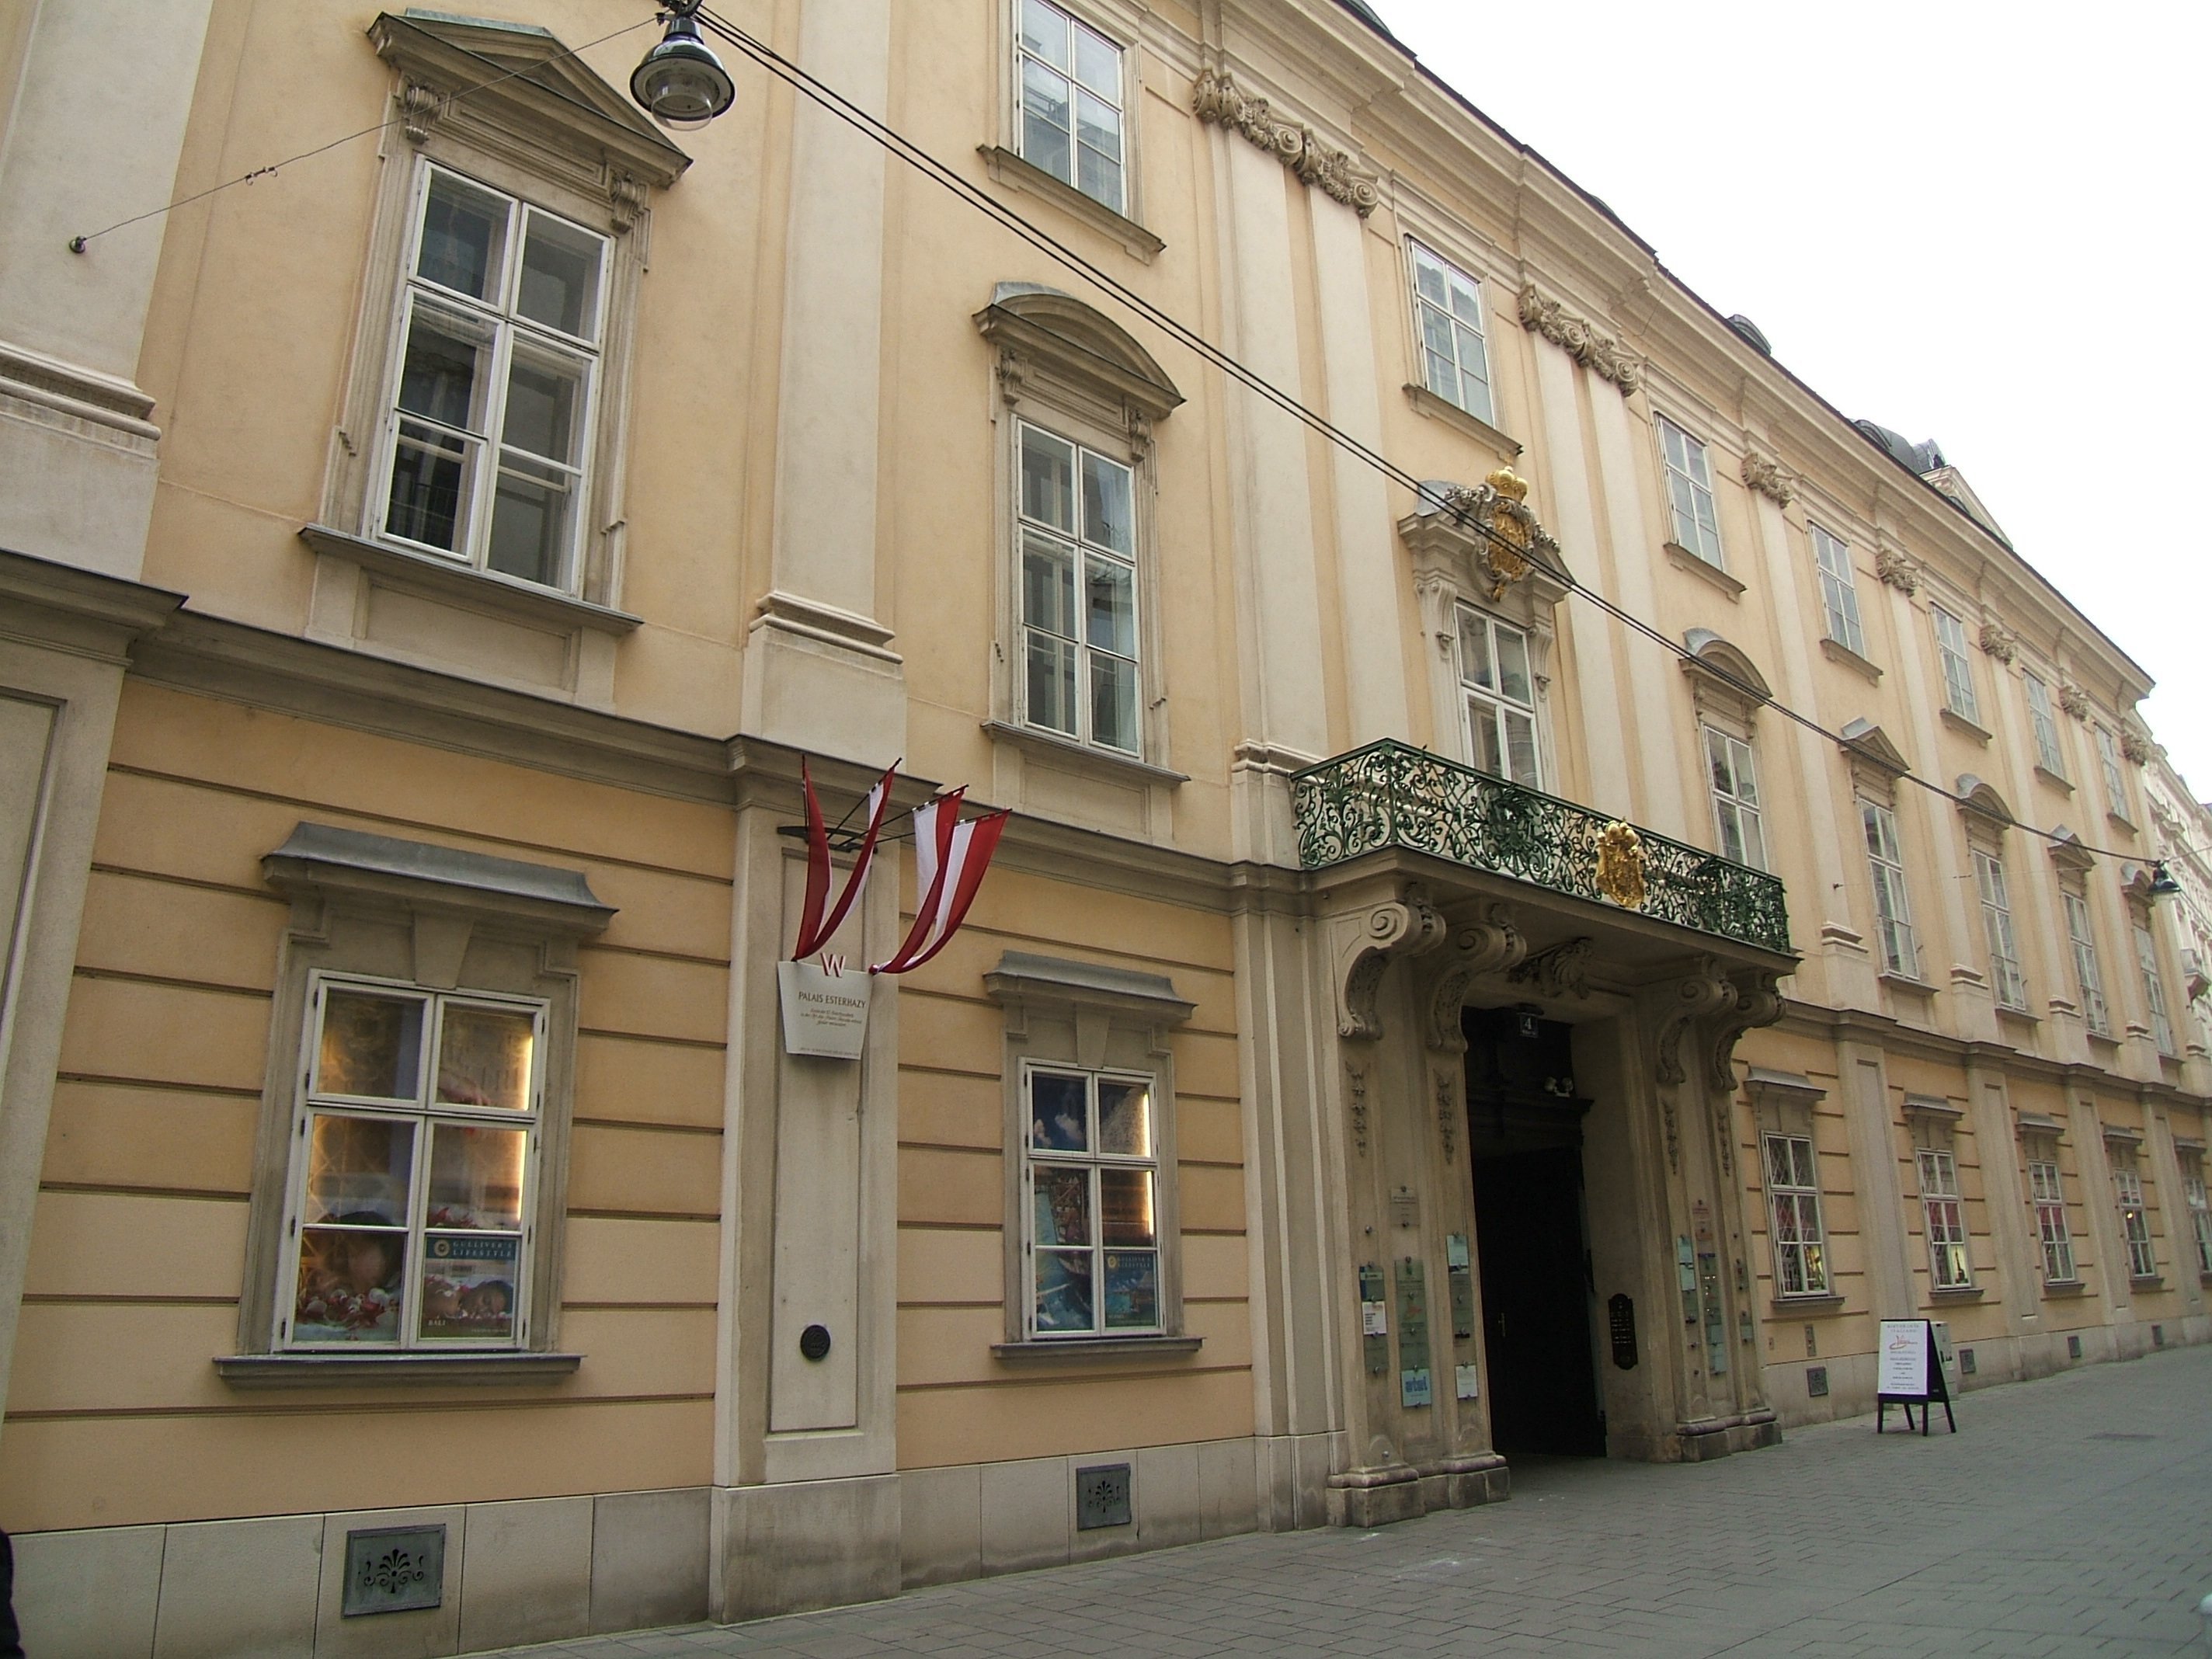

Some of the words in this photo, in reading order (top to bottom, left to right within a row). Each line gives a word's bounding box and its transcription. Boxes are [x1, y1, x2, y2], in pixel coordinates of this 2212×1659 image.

[798, 991, 823, 1003] PALAIS
[825, 995, 866, 1008] ESTERHAZY
[1525, 1017, 1532, 1030] 4
